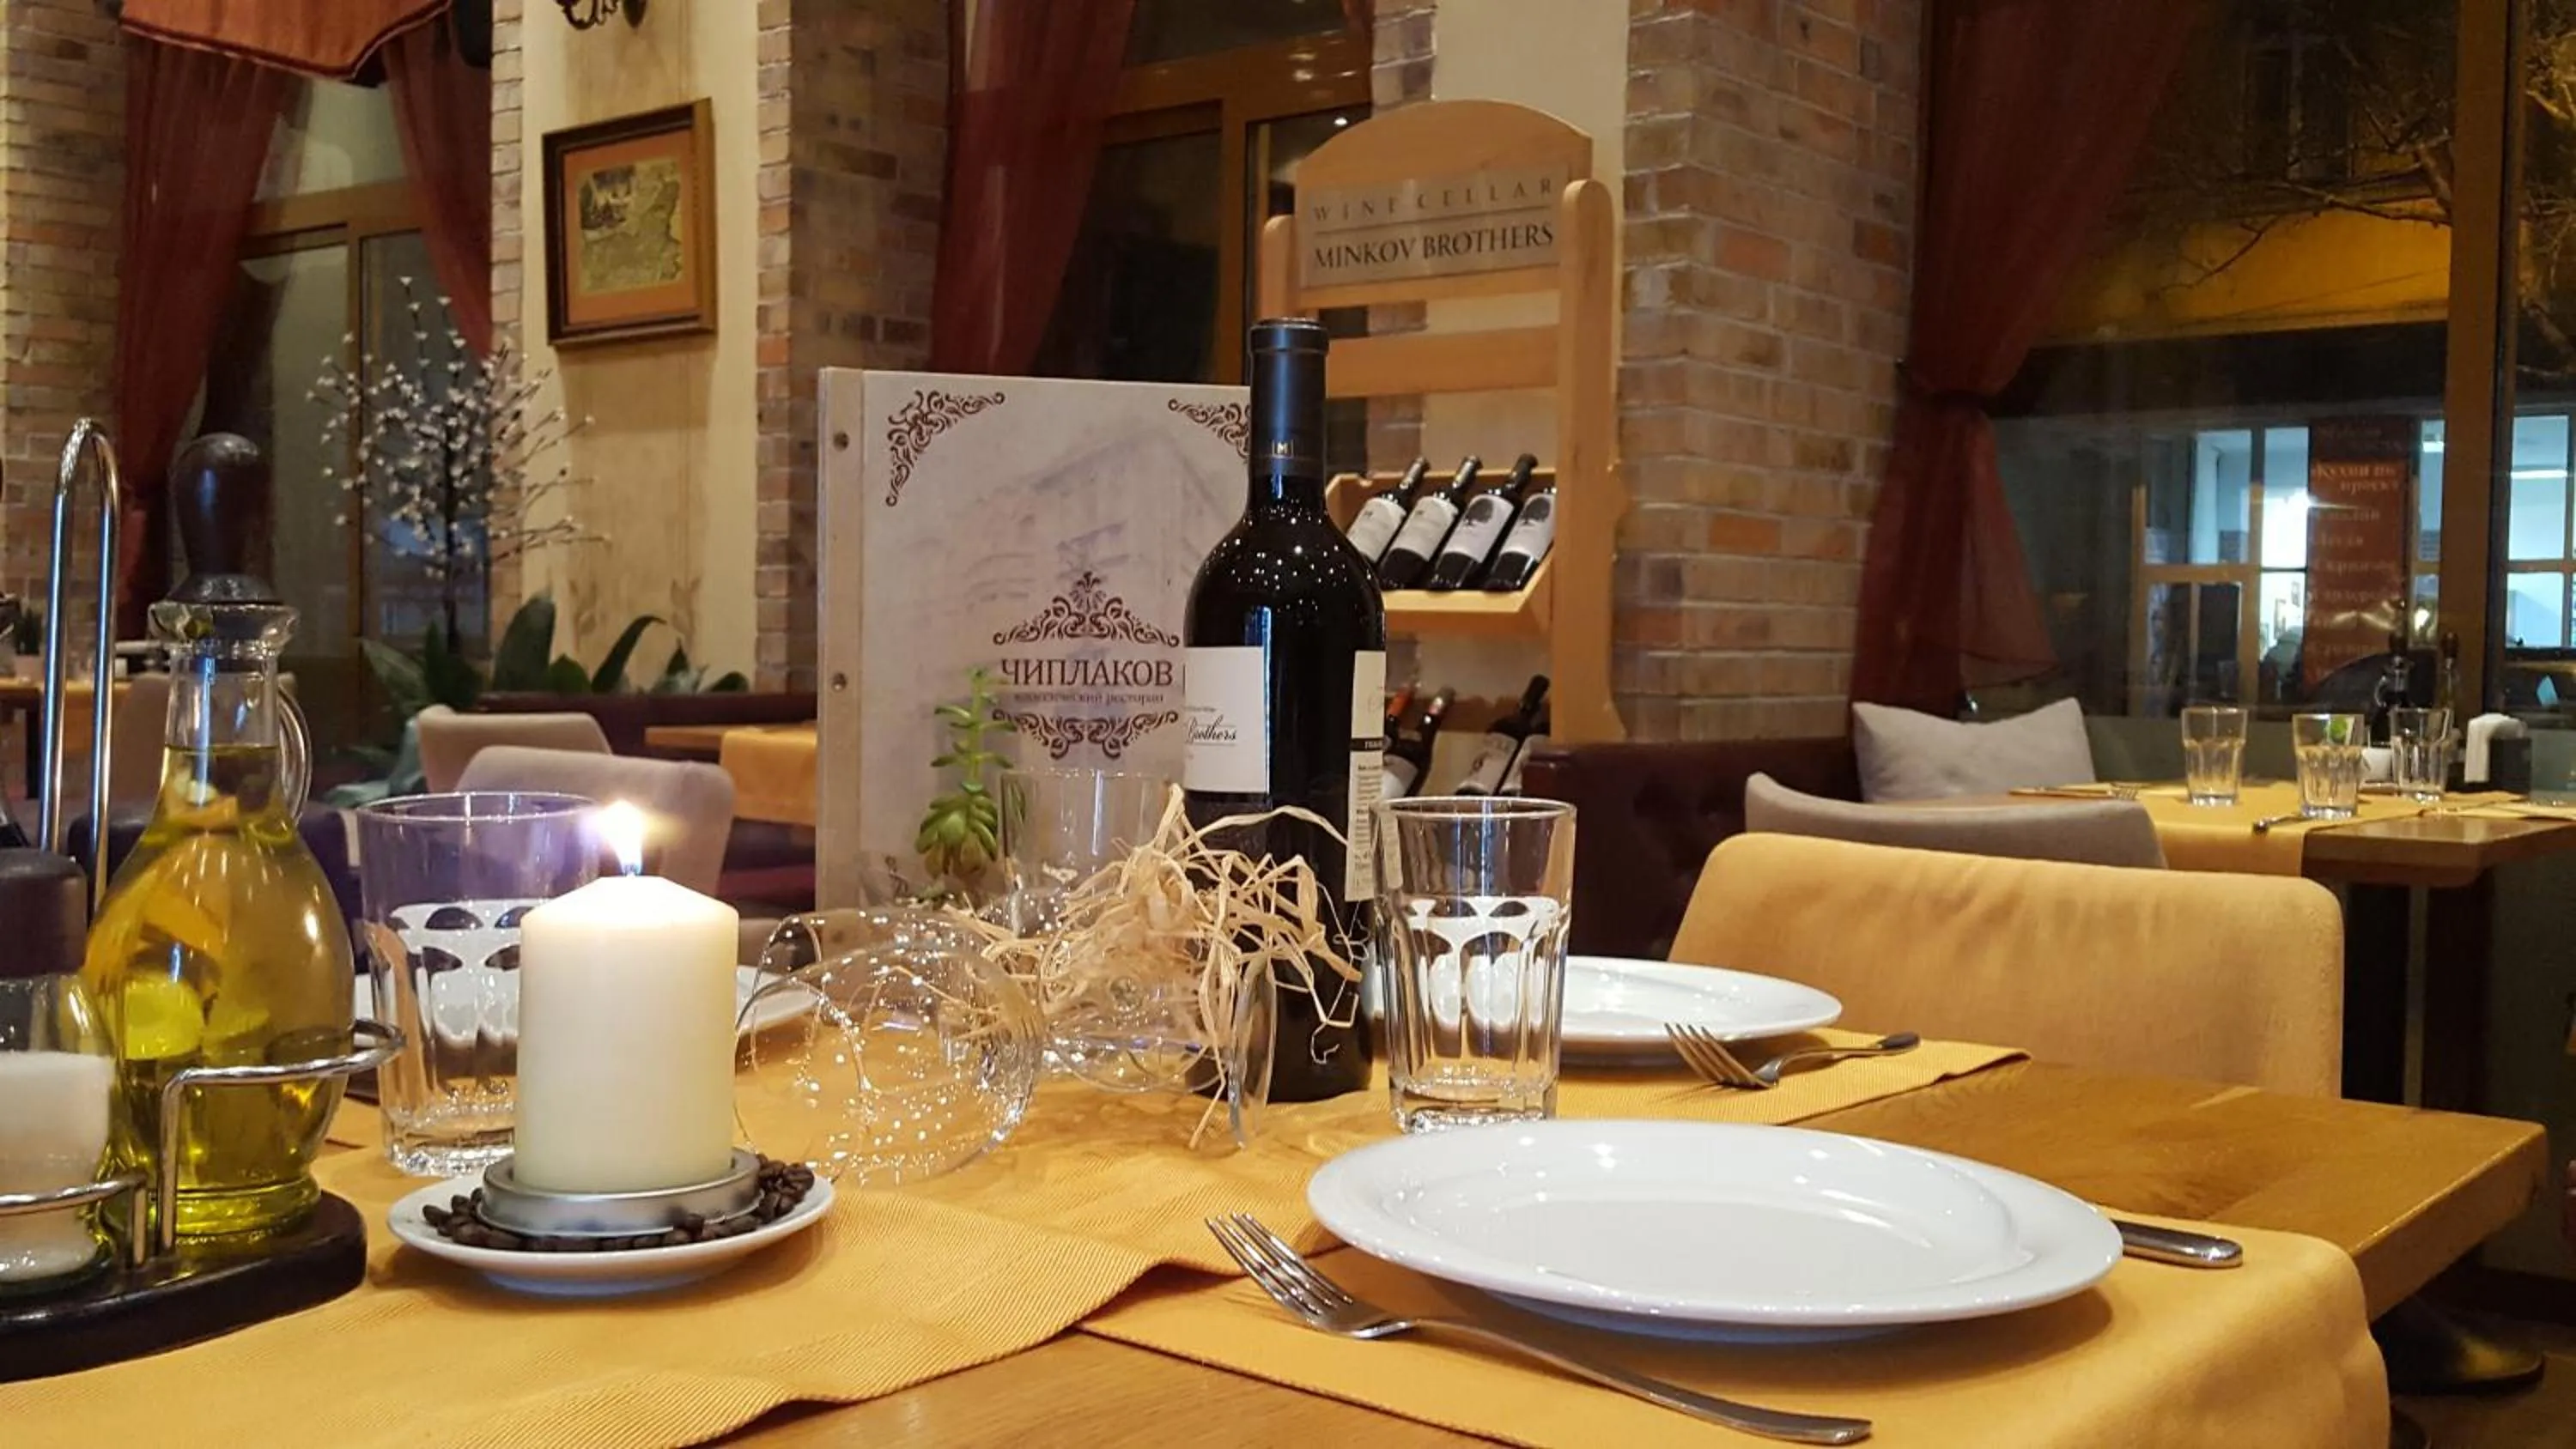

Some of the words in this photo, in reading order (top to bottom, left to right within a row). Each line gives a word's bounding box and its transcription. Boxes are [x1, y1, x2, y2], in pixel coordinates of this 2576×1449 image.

[1314, 196, 1400, 221] WINE
[1417, 178, 1552, 209] CELLAR
[1315, 238, 1418, 269] MINKOV
[1422, 221, 1554, 259] BROTHERS
[1000, 658, 1173, 687] ЧИПЛАКОВ
